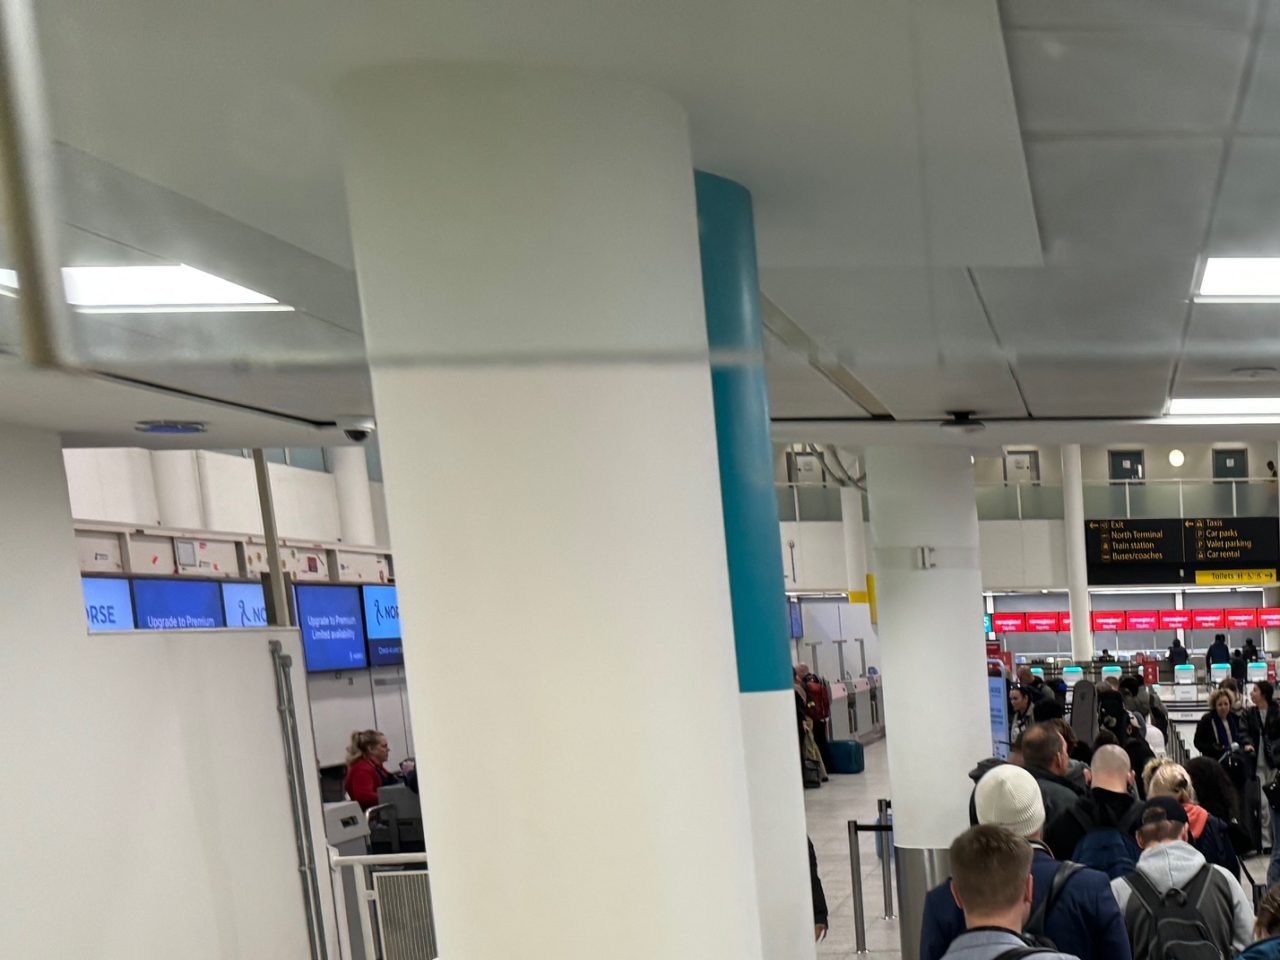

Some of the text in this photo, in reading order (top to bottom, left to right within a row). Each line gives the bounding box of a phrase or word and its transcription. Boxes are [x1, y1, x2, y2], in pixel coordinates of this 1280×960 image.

[1110, 520, 1124, 529] Exit
[1206, 519, 1223, 527] Taxis
[1111, 530, 1163, 539] North Terminal
[1206, 528, 1238, 539] Car parks
[1112, 541, 1155, 550] Train station
[1206, 539, 1252, 550] Valet parking
[1112, 551, 1163, 560] Buses/coaches
[1206, 549, 1240, 559] Car rental
[1211, 572, 1234, 580] Toilets
[86, 605, 117, 624] RSE
[147, 615, 215, 629] Upgrade to Premium
[307, 615, 329, 627] Upgrade
[336, 615, 357, 625] Premium
[311, 630, 330, 640] Limited
